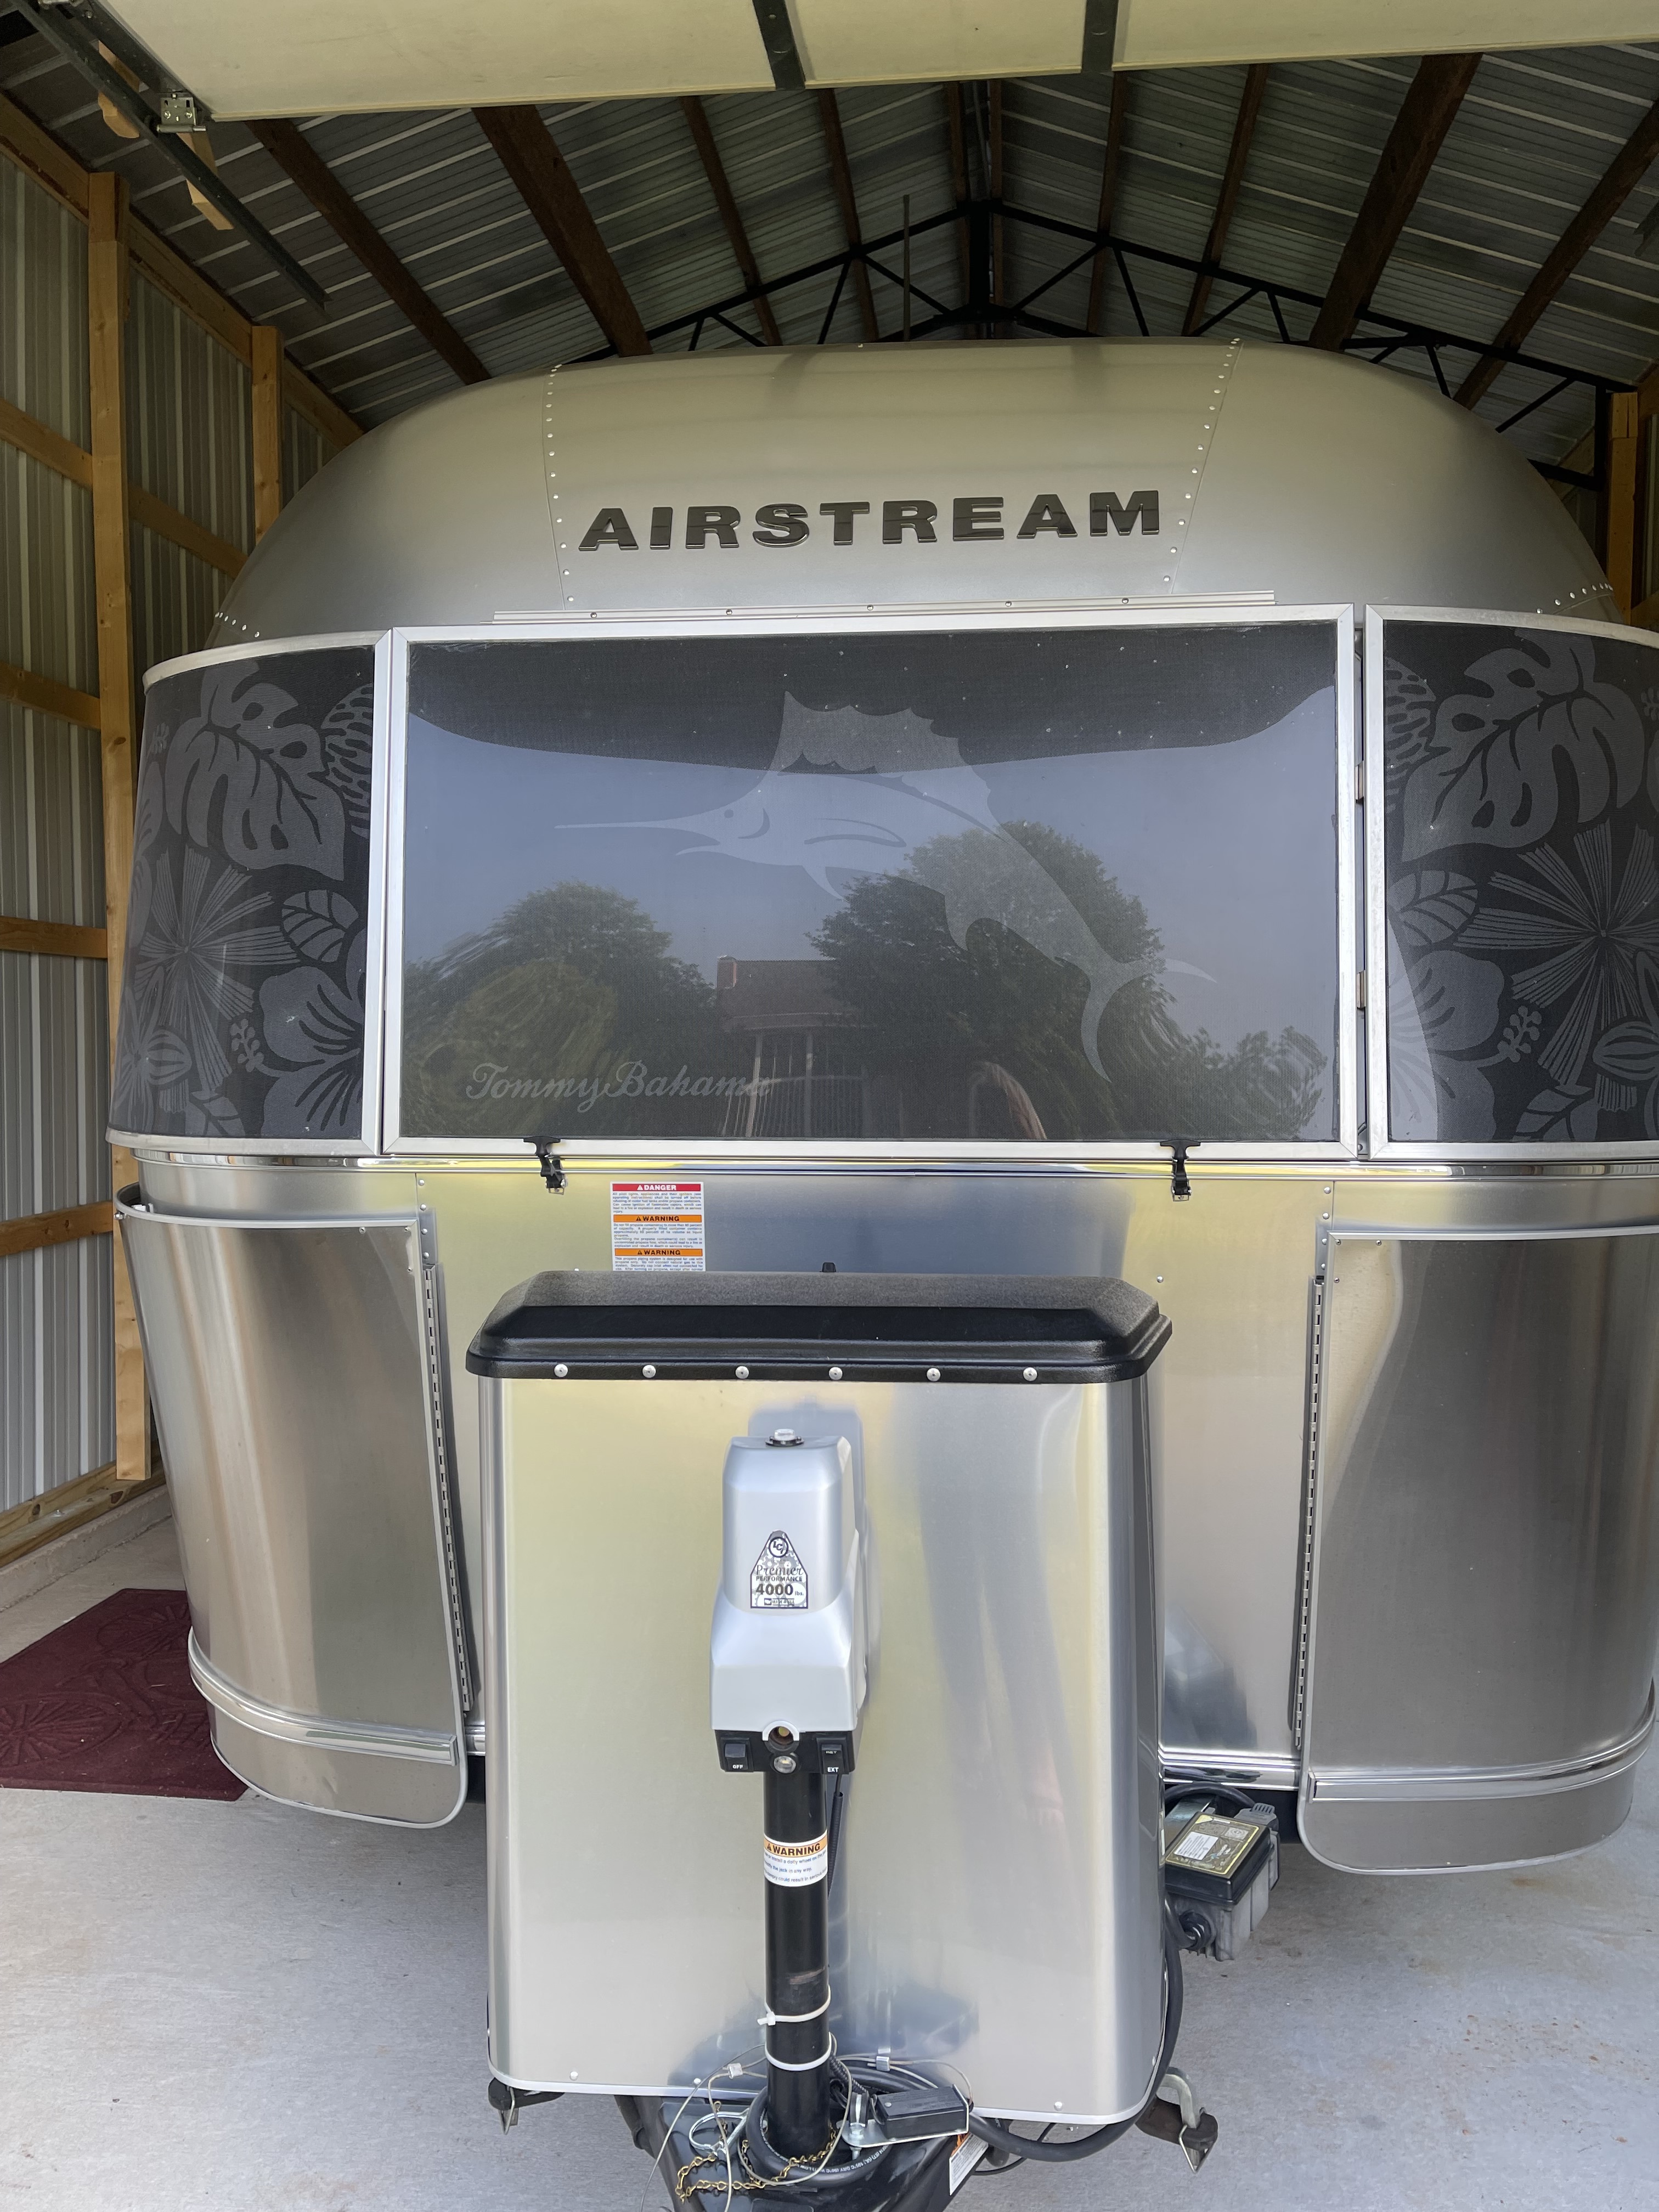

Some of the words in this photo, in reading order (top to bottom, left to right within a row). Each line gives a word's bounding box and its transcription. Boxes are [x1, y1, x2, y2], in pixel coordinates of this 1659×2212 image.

[578, 489, 1160, 551] AIRSTREAM
[466, 1062, 601, 1113] Tommy
[756, 1565, 804, 1576] Premier
[755, 1583, 794, 1596] 4000
[772, 1843, 820, 1856] WARNING
